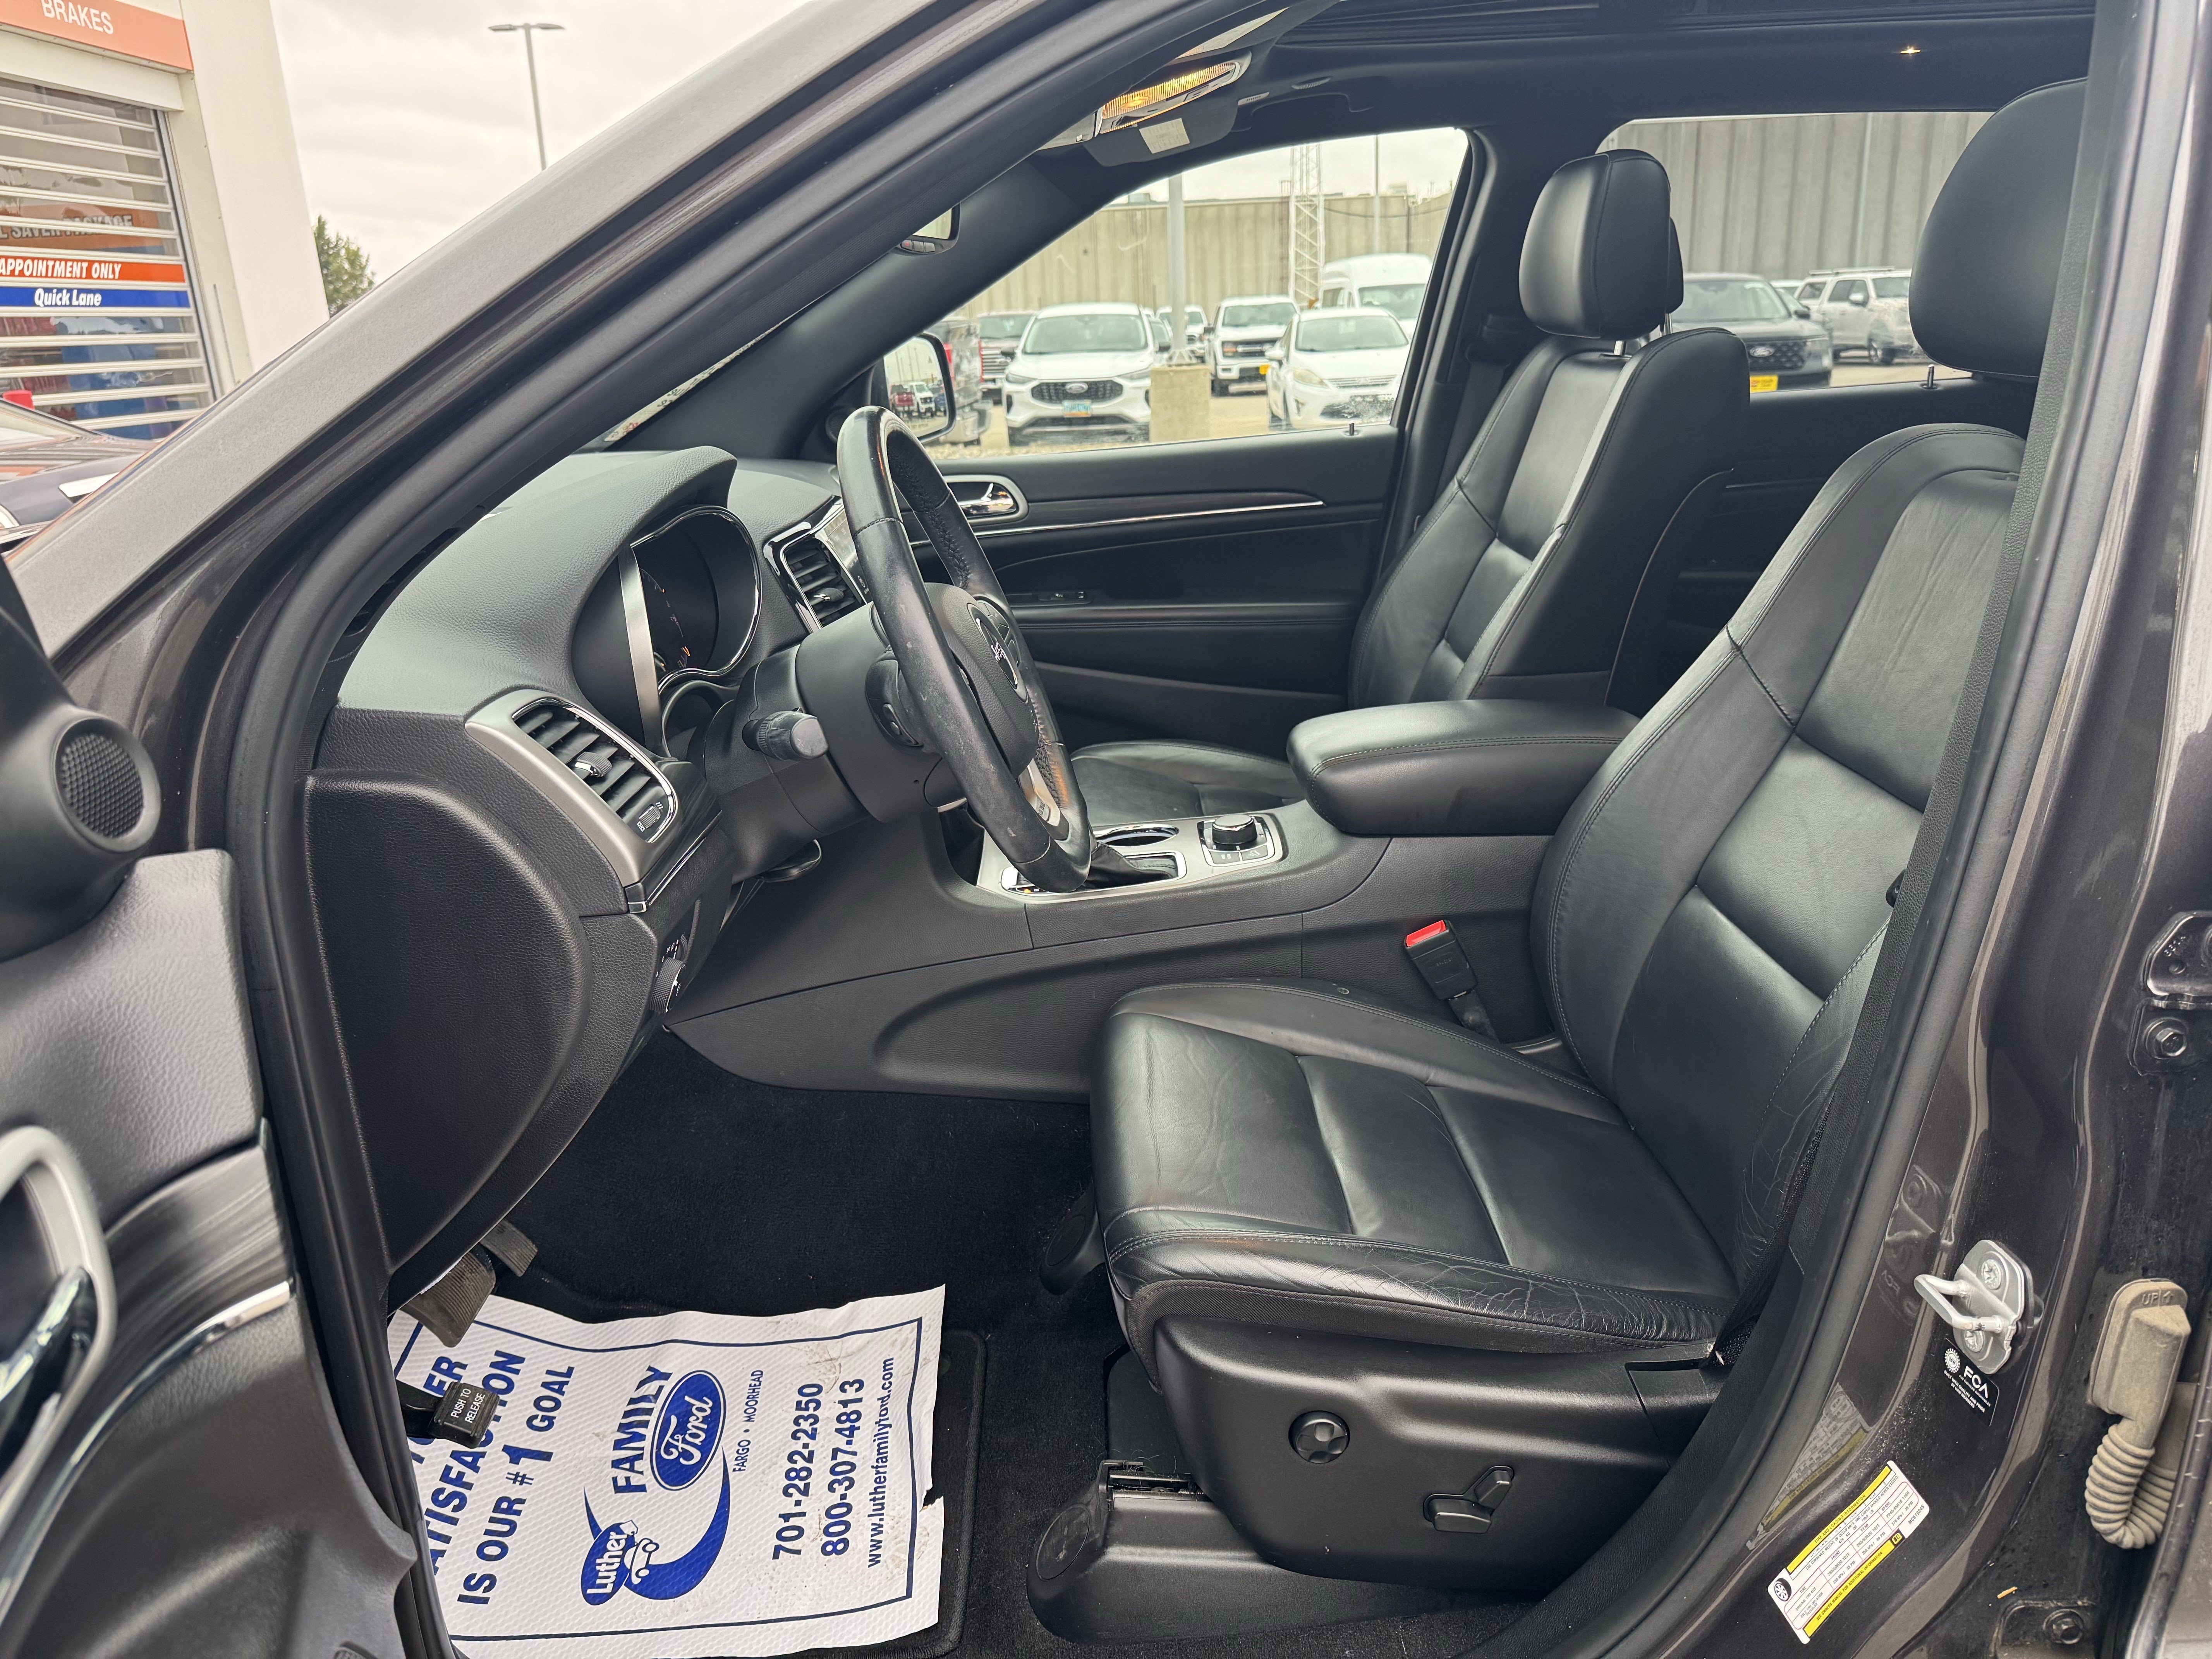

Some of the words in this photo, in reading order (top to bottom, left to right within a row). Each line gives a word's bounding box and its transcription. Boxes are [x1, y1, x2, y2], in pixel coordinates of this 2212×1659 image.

[41, 0, 113, 34] BRAKES
[0, 258, 88, 278] APPOINTMENT
[91, 262, 122, 279] ONLY
[34, 288, 70, 307] Quick
[72, 289, 102, 306] Lane
[2141, 1292, 2159, 1305] UP
[450, 1399, 467, 1419] PUSH
[460, 1388, 471, 1400] TO
[526, 1366, 575, 1432] GOAL
[1964, 1365, 1988, 1398] FCA
[465, 1393, 486, 1424] RELEASE
[611, 1365, 673, 1494] FAMILY
[660, 1395, 713, 1465] Ford
[733, 1439, 751, 1472] FARGO
[743, 1370, 763, 1422] MOORHEAD
[424, 1350, 526, 1575] ATISFAON
[772, 1383, 823, 1560] 701-282-2350
[821, 1379, 864, 1556] 800-307-4813
[476, 1496, 527, 1561] OUR
[1843, 1494, 1865, 1516] INFORMATION
[587, 1532, 628, 1594] Luther
[457, 1573, 497, 1604] IS
